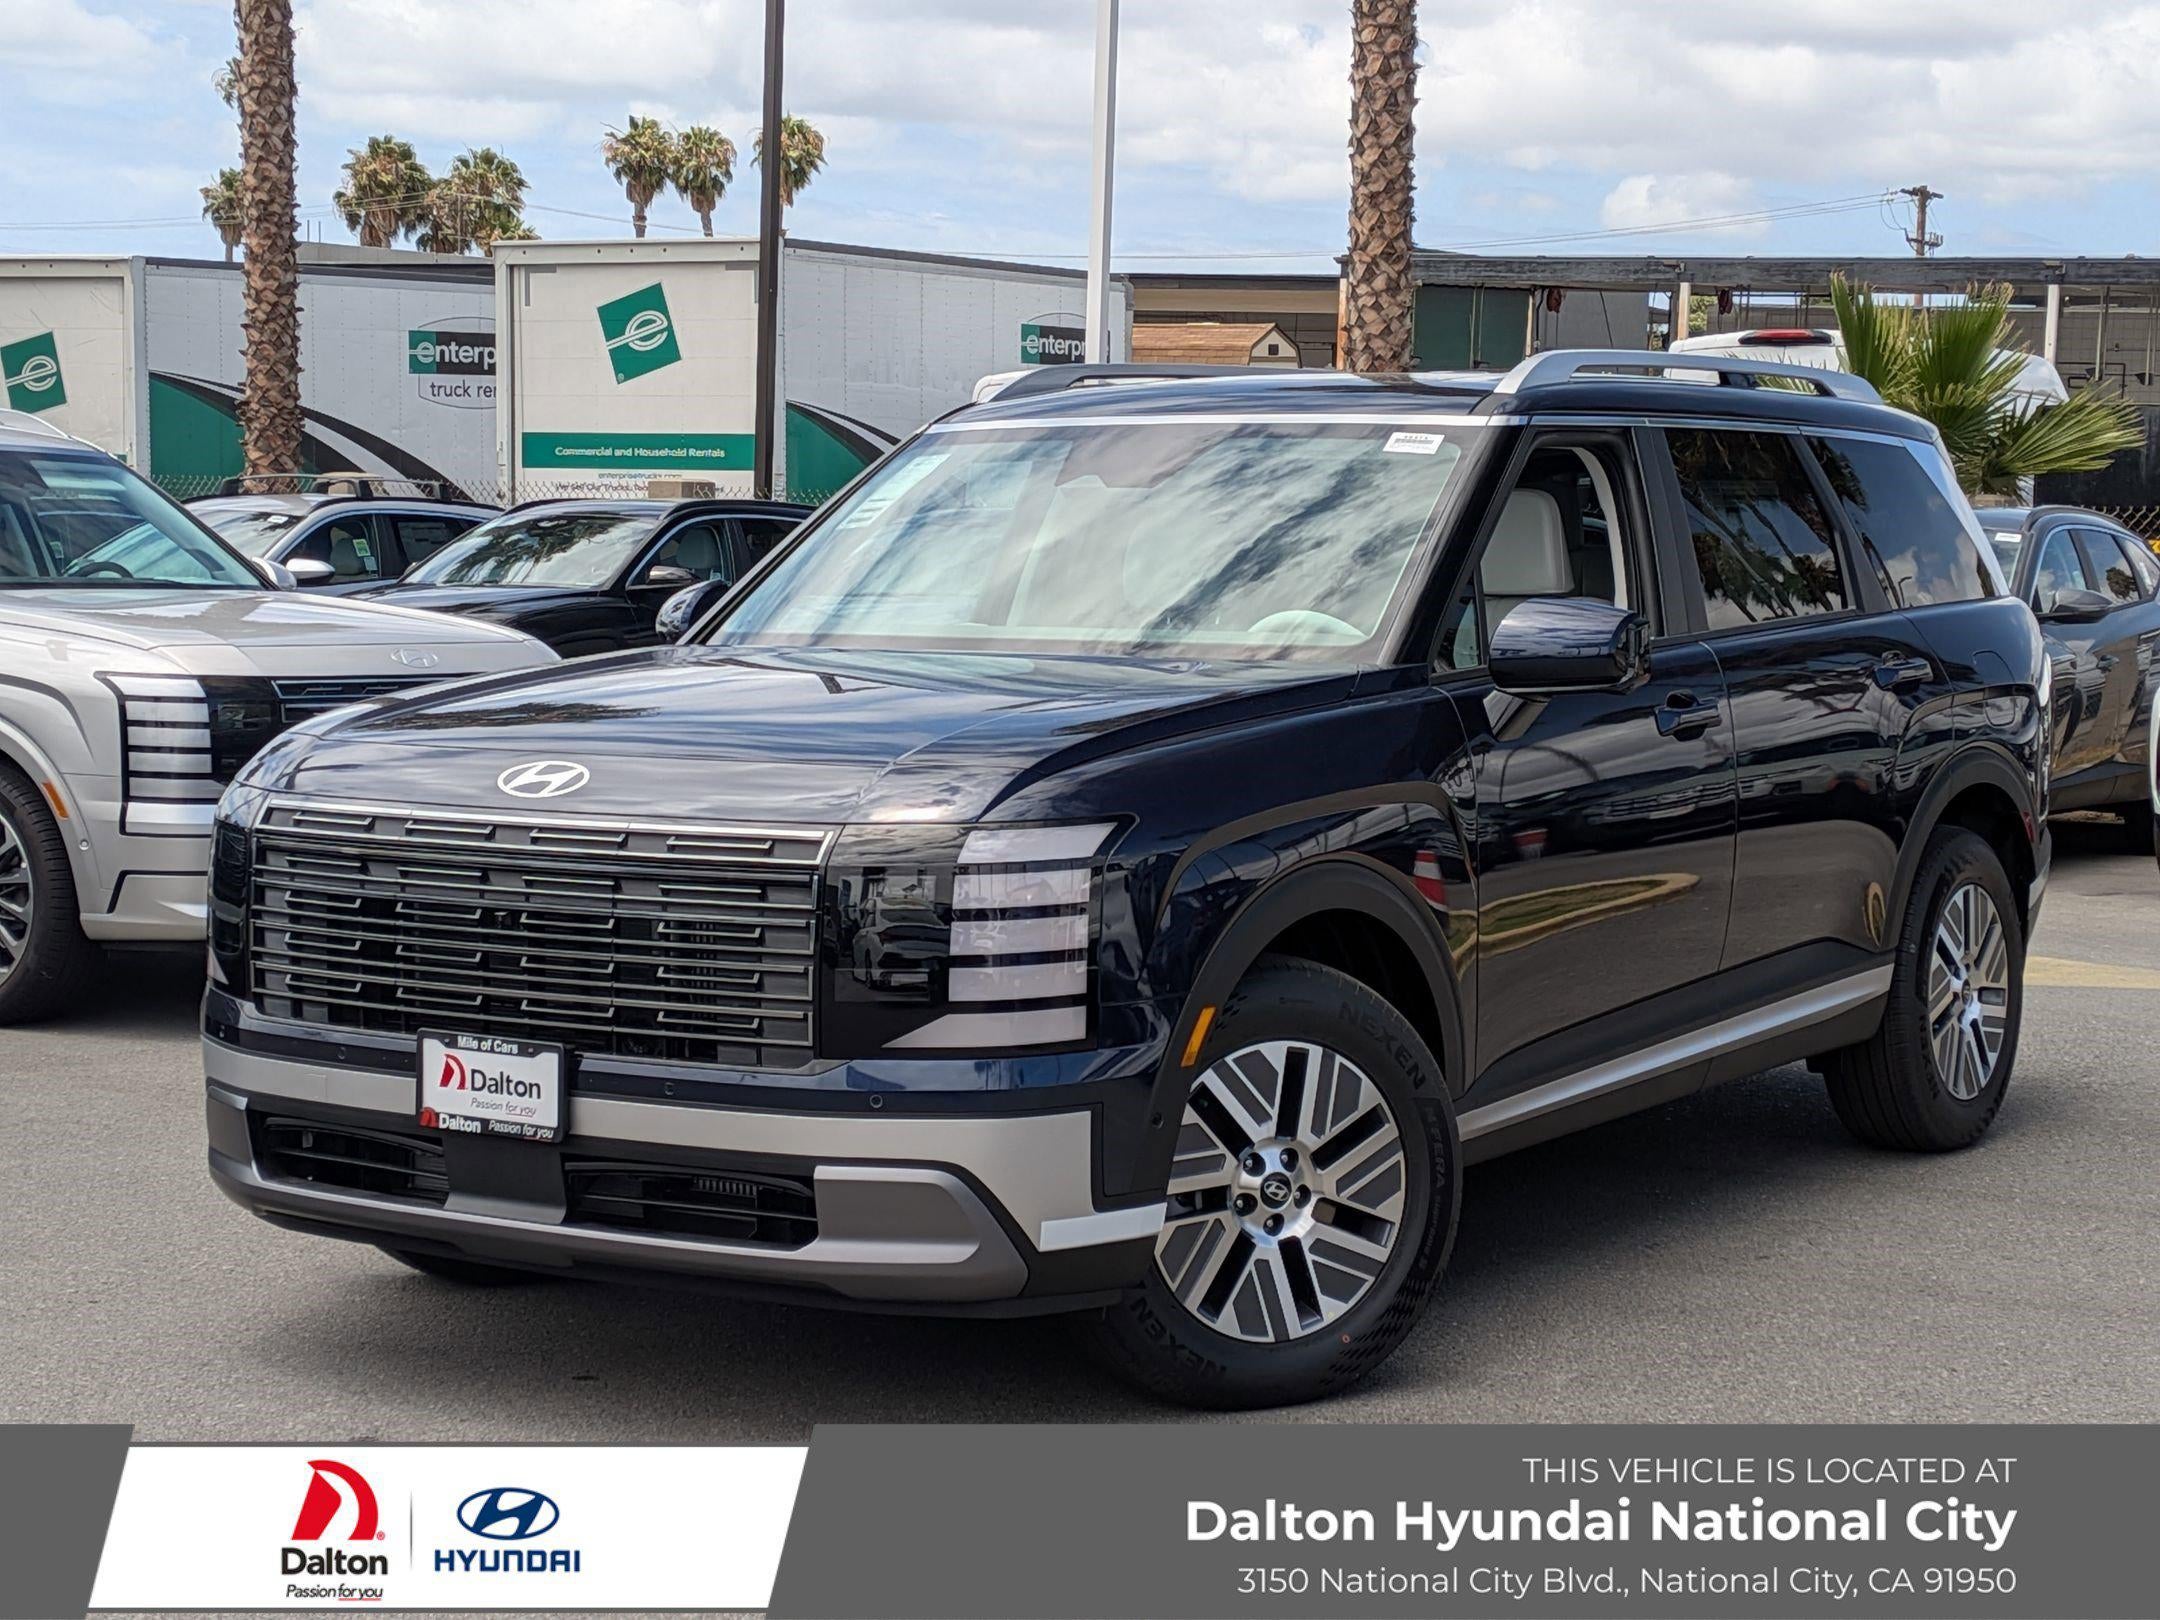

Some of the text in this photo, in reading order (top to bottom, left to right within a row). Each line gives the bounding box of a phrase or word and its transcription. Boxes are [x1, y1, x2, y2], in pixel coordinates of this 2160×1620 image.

[429, 379, 472, 398] truck
[554, 446, 726, 458] Commercial and Household Rentals
[457, 1035, 519, 1055] Mile of Cars
[470, 1067, 541, 1099] Dalton
[470, 1097, 538, 1117] Passion for you
[438, 1112, 555, 1140] Dalton Passion for you
